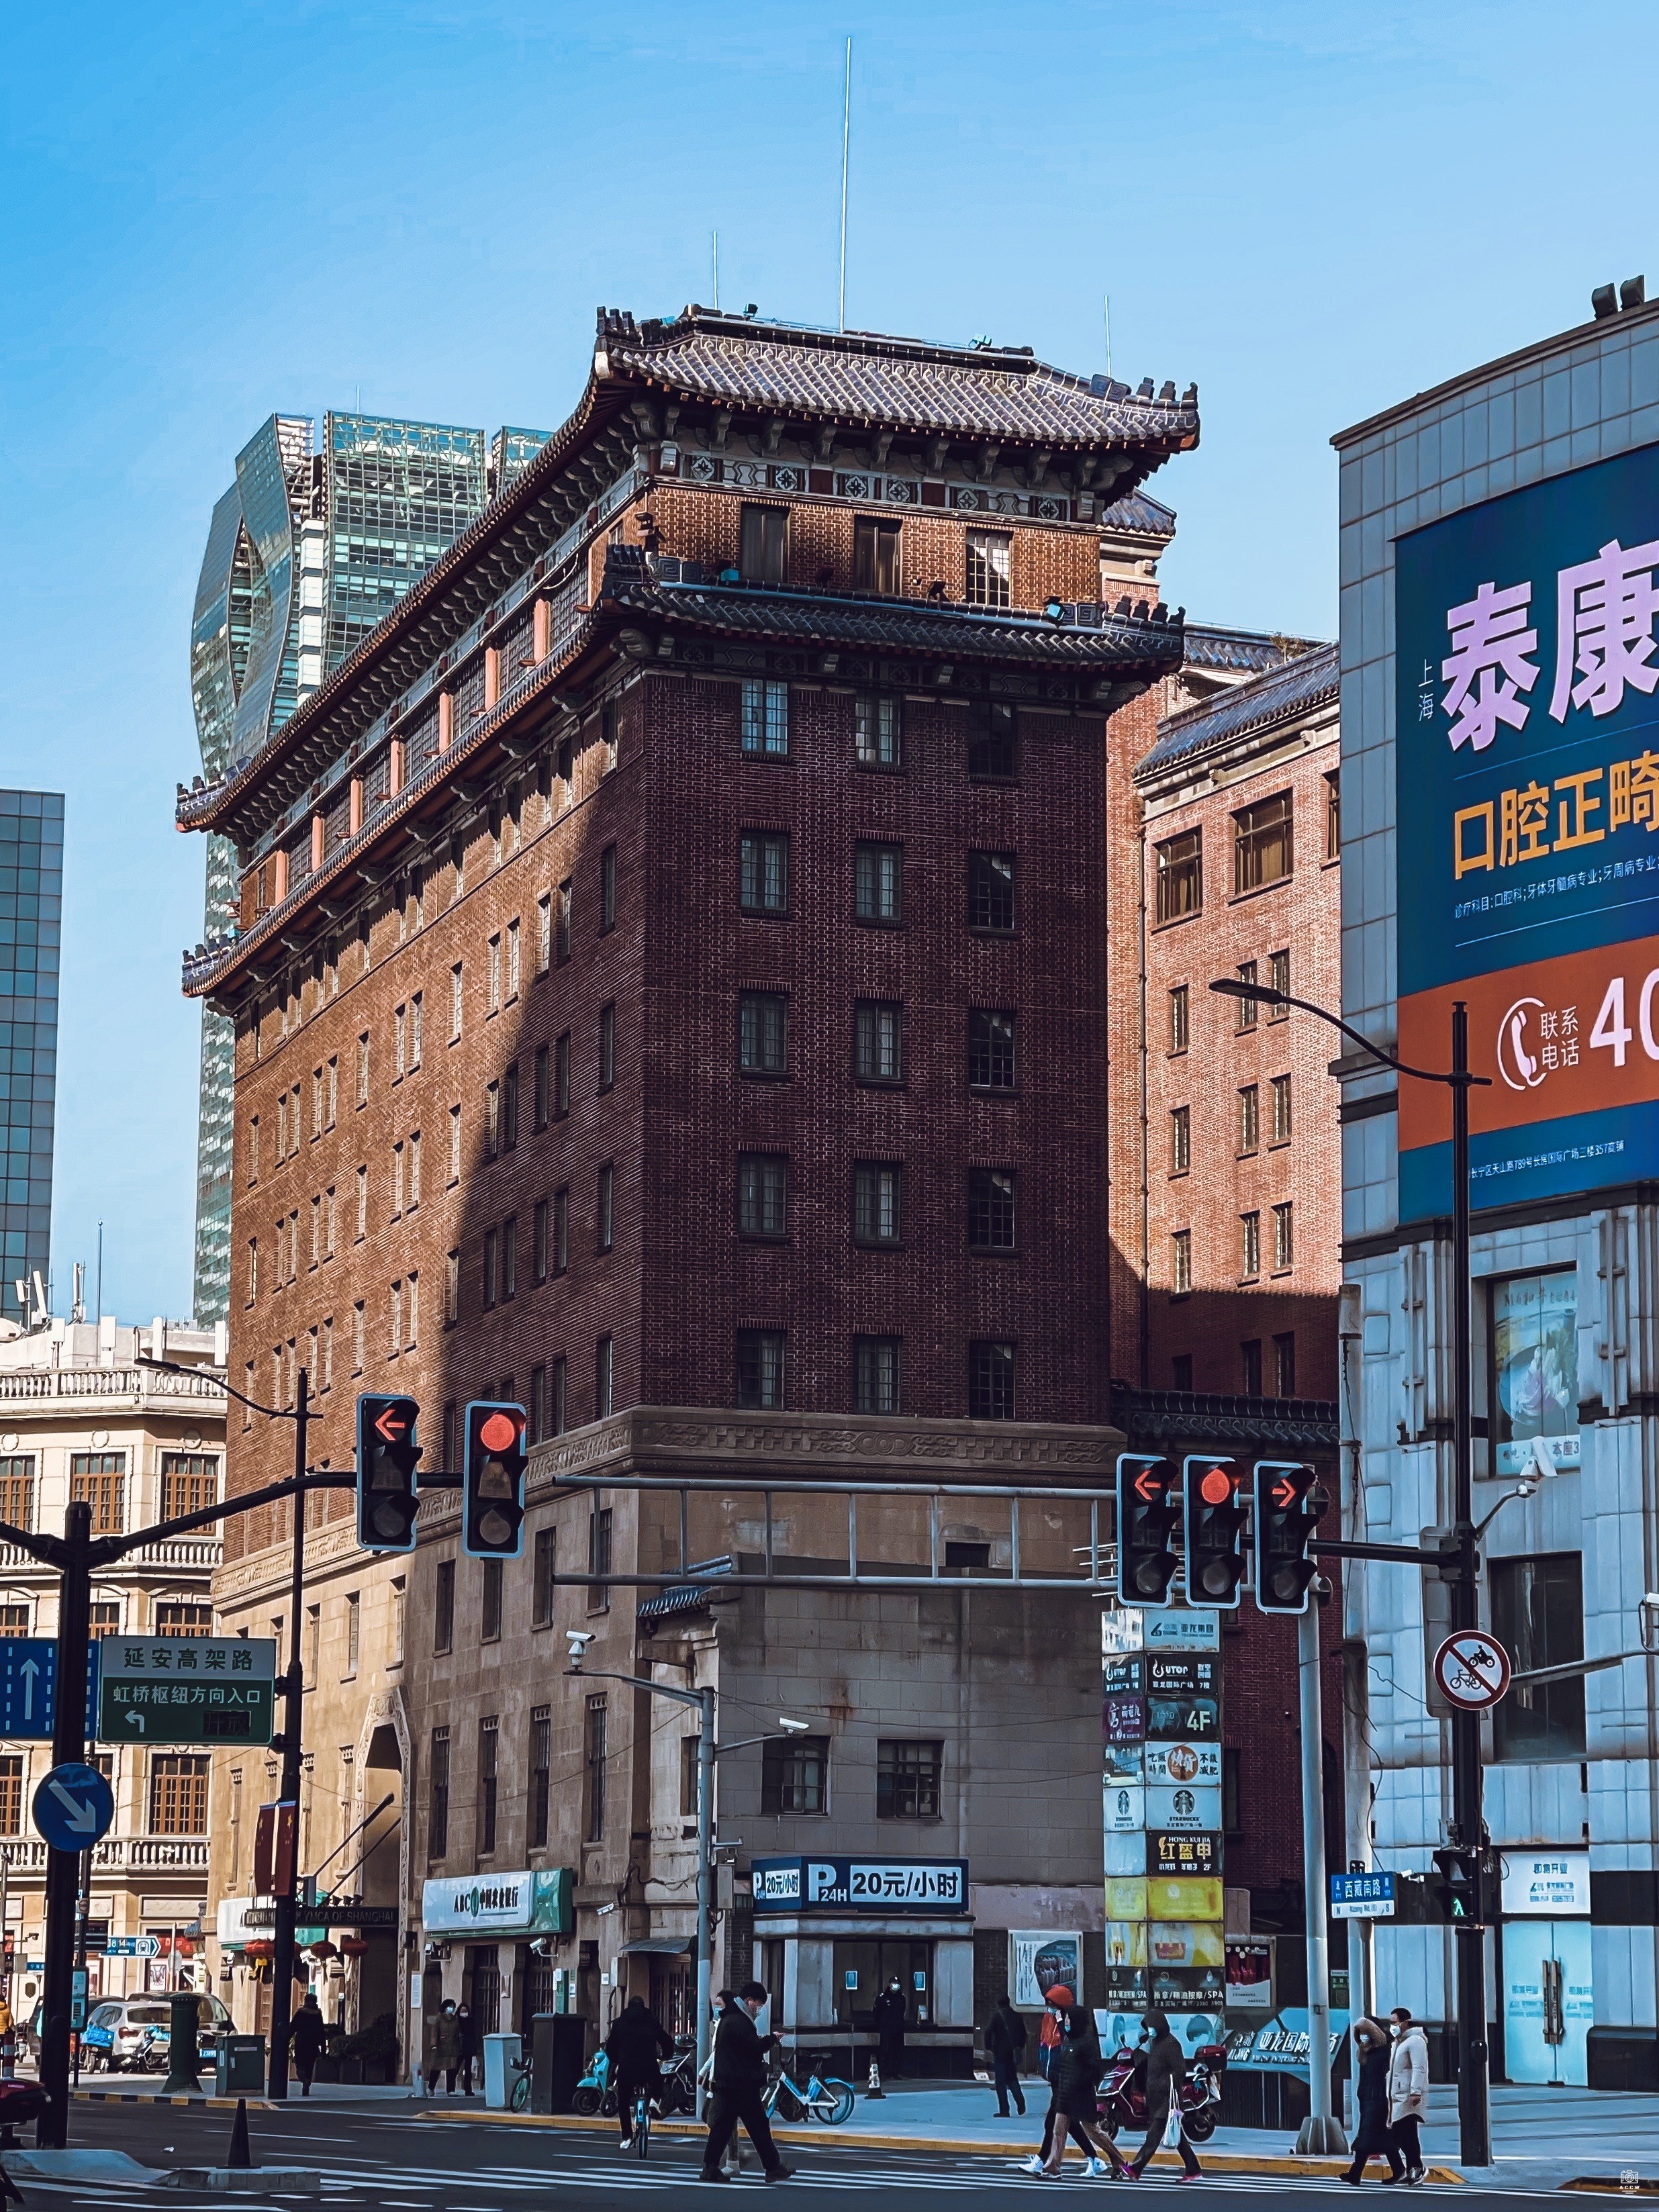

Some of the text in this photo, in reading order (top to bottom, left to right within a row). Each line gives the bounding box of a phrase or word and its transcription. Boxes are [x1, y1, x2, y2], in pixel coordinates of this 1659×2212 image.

[1441, 539, 1659, 751] 泰康
[1418, 659, 1434, 722] 上海
[1454, 750, 1659, 880] 口腔正畸
[1540, 1006, 1578, 1040] 联系
[1542, 1038, 1579, 1070] 电话
[124, 1647, 253, 1672] 延安高架路
[113, 1686, 261, 1704] 虹桥枢纽方向入口
[1186, 1711, 1211, 1731] 4F
[1159, 1837, 1211, 1860] 红盔甲
[766, 1873, 799, 1894] 20元/小时
[808, 1864, 837, 1901] P
[852, 1871, 959, 1898] 20元/小时
[454, 1893, 471, 1913] ABC
[820, 1888, 847, 1902] 24H
[305, 1912, 330, 1923] YMCA
[332, 1911, 345, 1922] OF
[346, 1911, 393, 1923] SHANGHAI
[1336, 1907, 1341, 1915] N
[1258, 2031, 1337, 2053] 亚龙国际场
